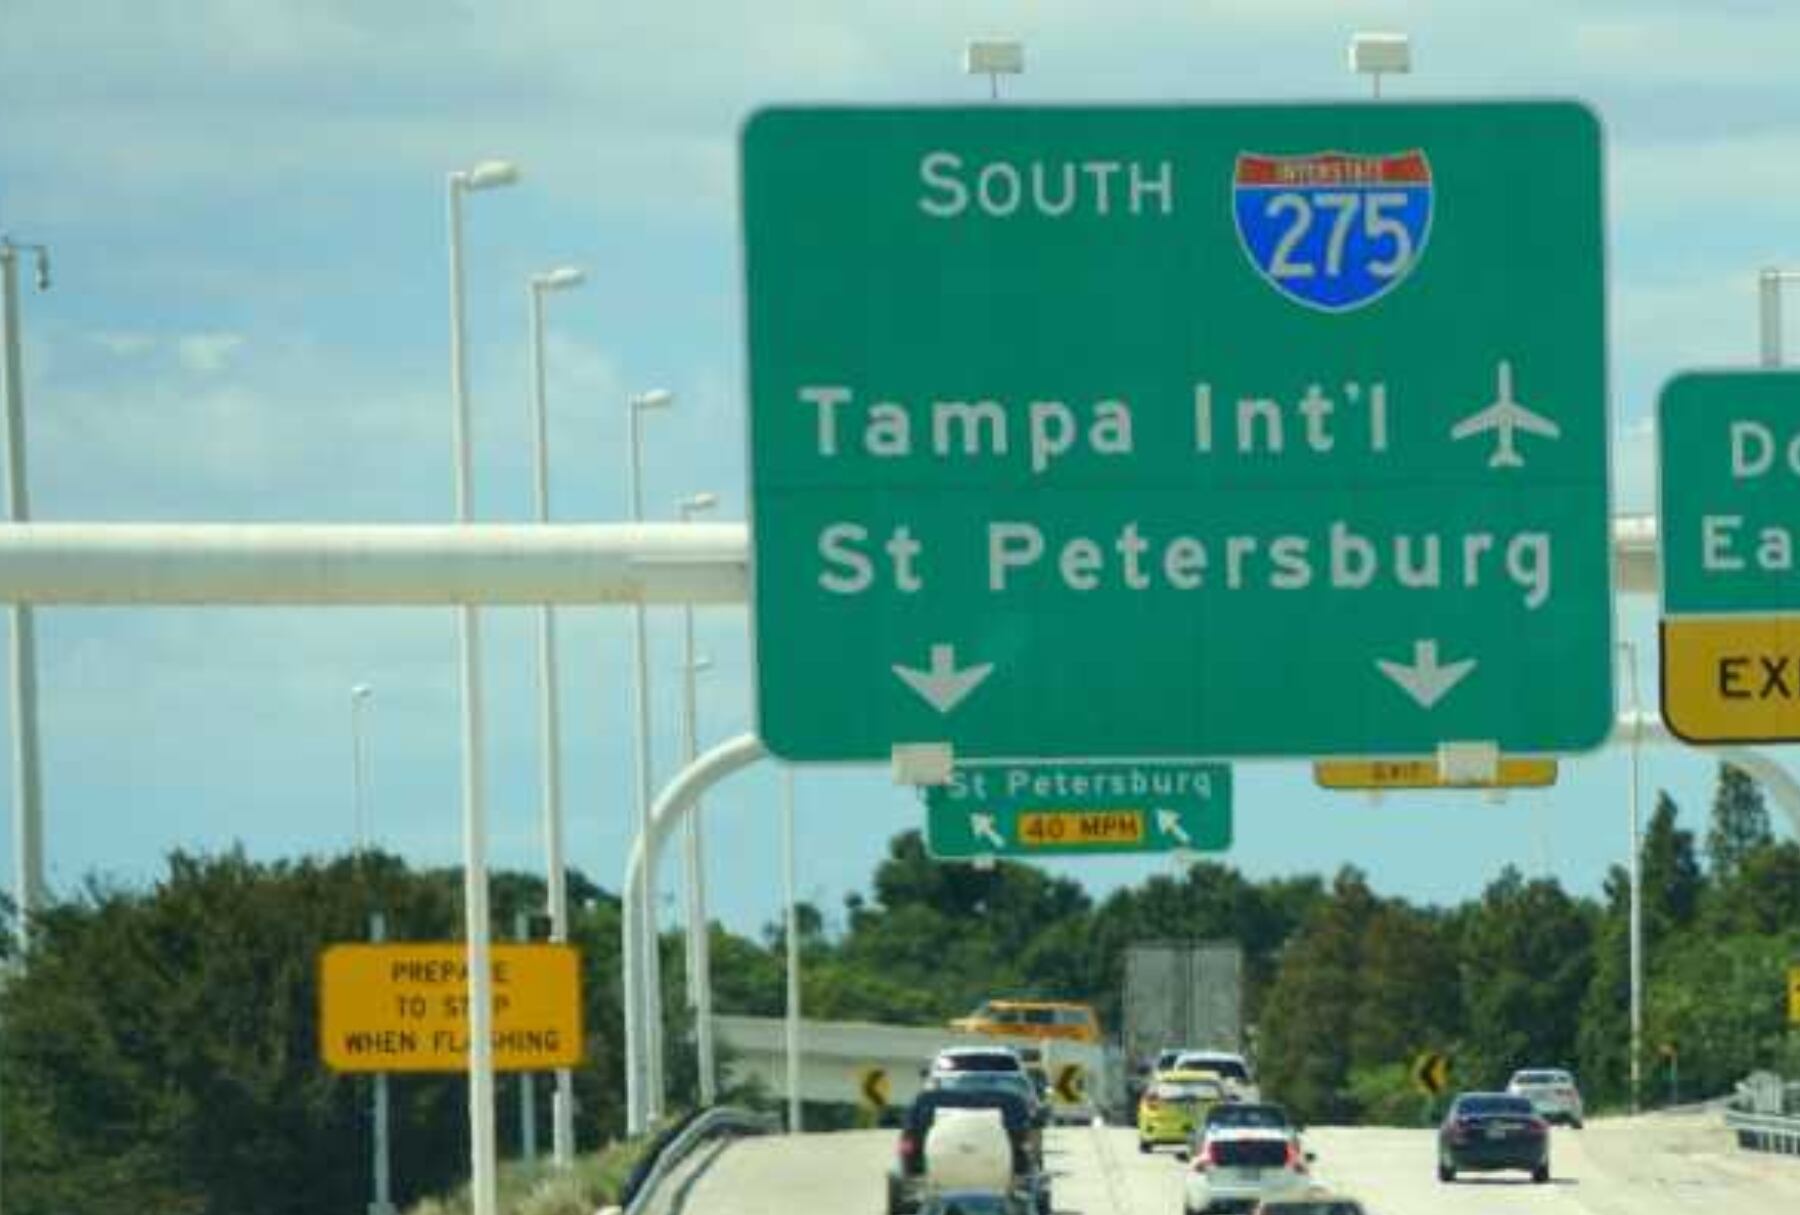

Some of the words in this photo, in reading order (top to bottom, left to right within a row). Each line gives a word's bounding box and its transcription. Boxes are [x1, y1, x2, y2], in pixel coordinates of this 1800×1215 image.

[919, 153, 1173, 215] SOUTH
[1266, 192, 1411, 277] 275
[801, 386, 1133, 473] Tampa
[1196, 383, 1388, 452] Int'l
[818, 525, 924, 594] St
[988, 522, 1552, 608] Petersburg
[948, 771, 987, 799] St
[1007, 768, 1212, 798] Petersburg
[1025, 817, 1066, 839] 40
[1079, 813, 1139, 837] MPH
[391, 960, 509, 983] PREPAE
[398, 996, 427, 1019] TO
[443, 996, 510, 1019] STP
[345, 1030, 417, 1054] WHEN
[433, 1029, 561, 1054] FLHING
